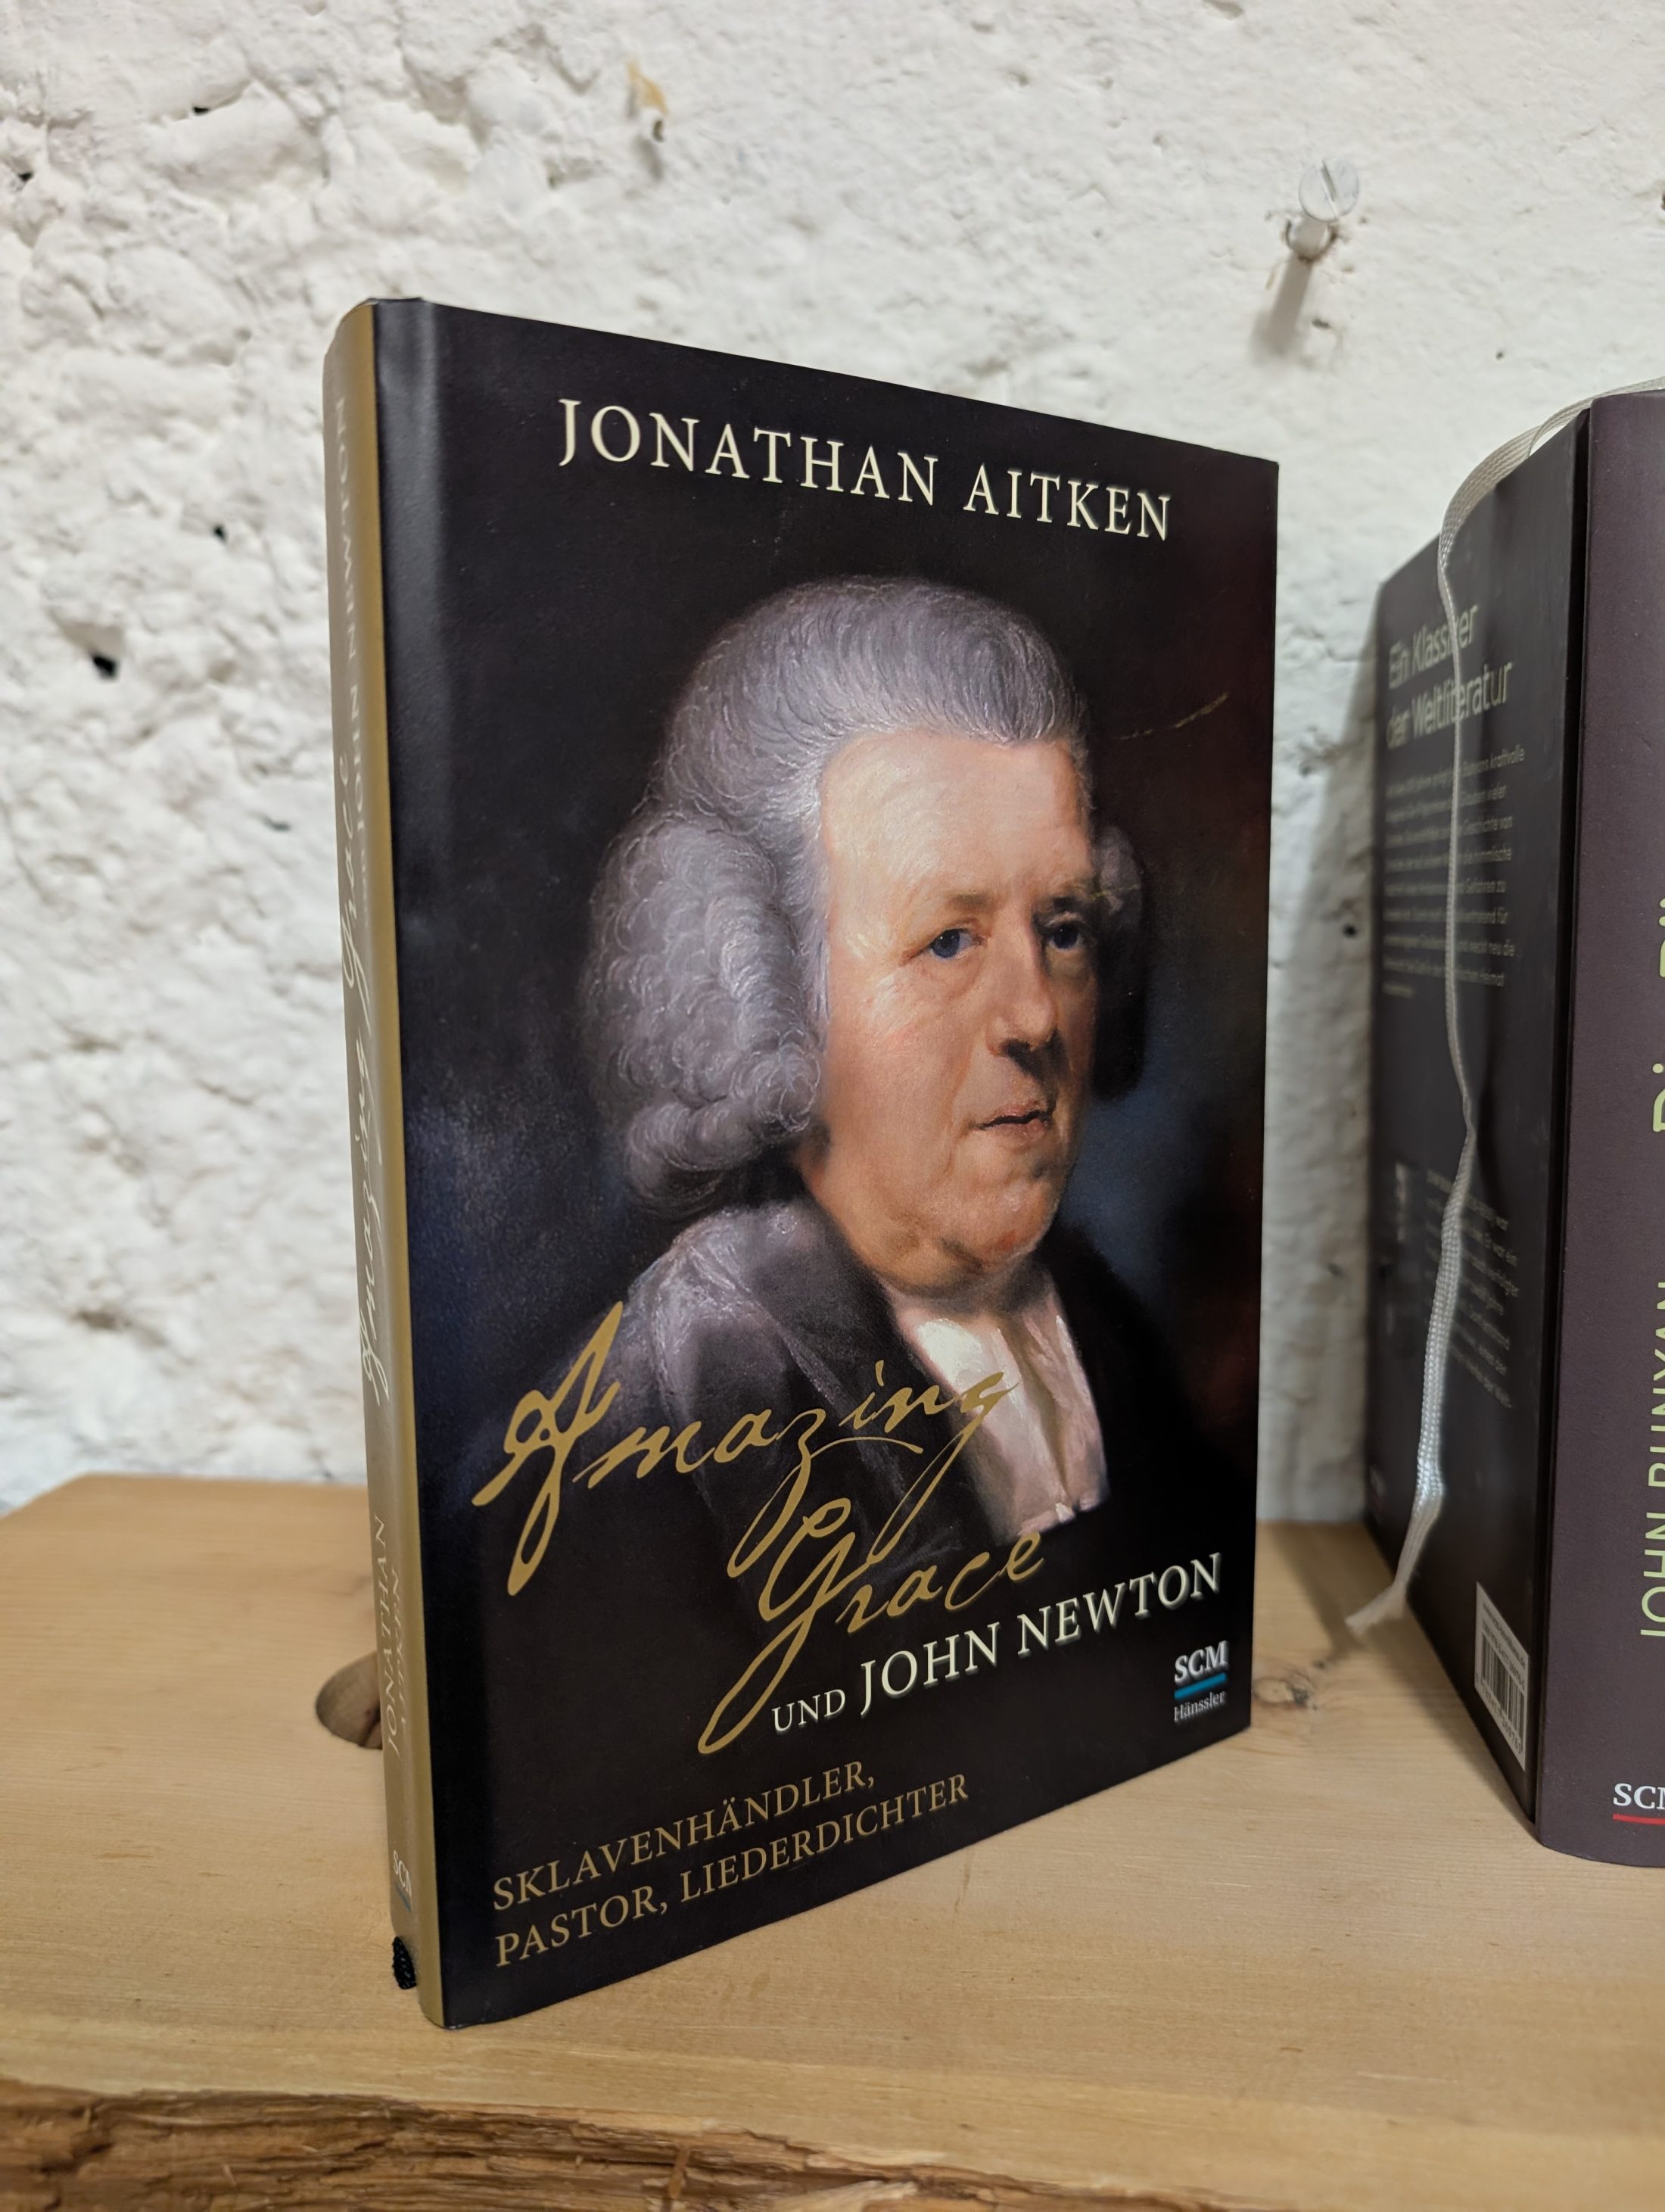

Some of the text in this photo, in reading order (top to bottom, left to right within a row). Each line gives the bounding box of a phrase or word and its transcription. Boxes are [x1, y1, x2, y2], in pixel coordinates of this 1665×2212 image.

[335, 396, 356, 662] NEWTON
[559, 398, 1171, 541] JONATHAN AITKEN
[350, 684, 366, 832] JOHN
[471, 1301, 1022, 1595] Amazing
[375, 1514, 400, 1759] JONATHAN
[697, 1498, 1044, 1754] Grace
[772, 1552, 1224, 1734] UND JOHN NEWTON
[1174, 1640, 1229, 1685] SCM
[1174, 1690, 1228, 1723] Hänssler
[493, 1760, 875, 1911] SKLAVENHÄNDLER,
[495, 1773, 969, 1967] PASTOR, LIEDERDICHTER
